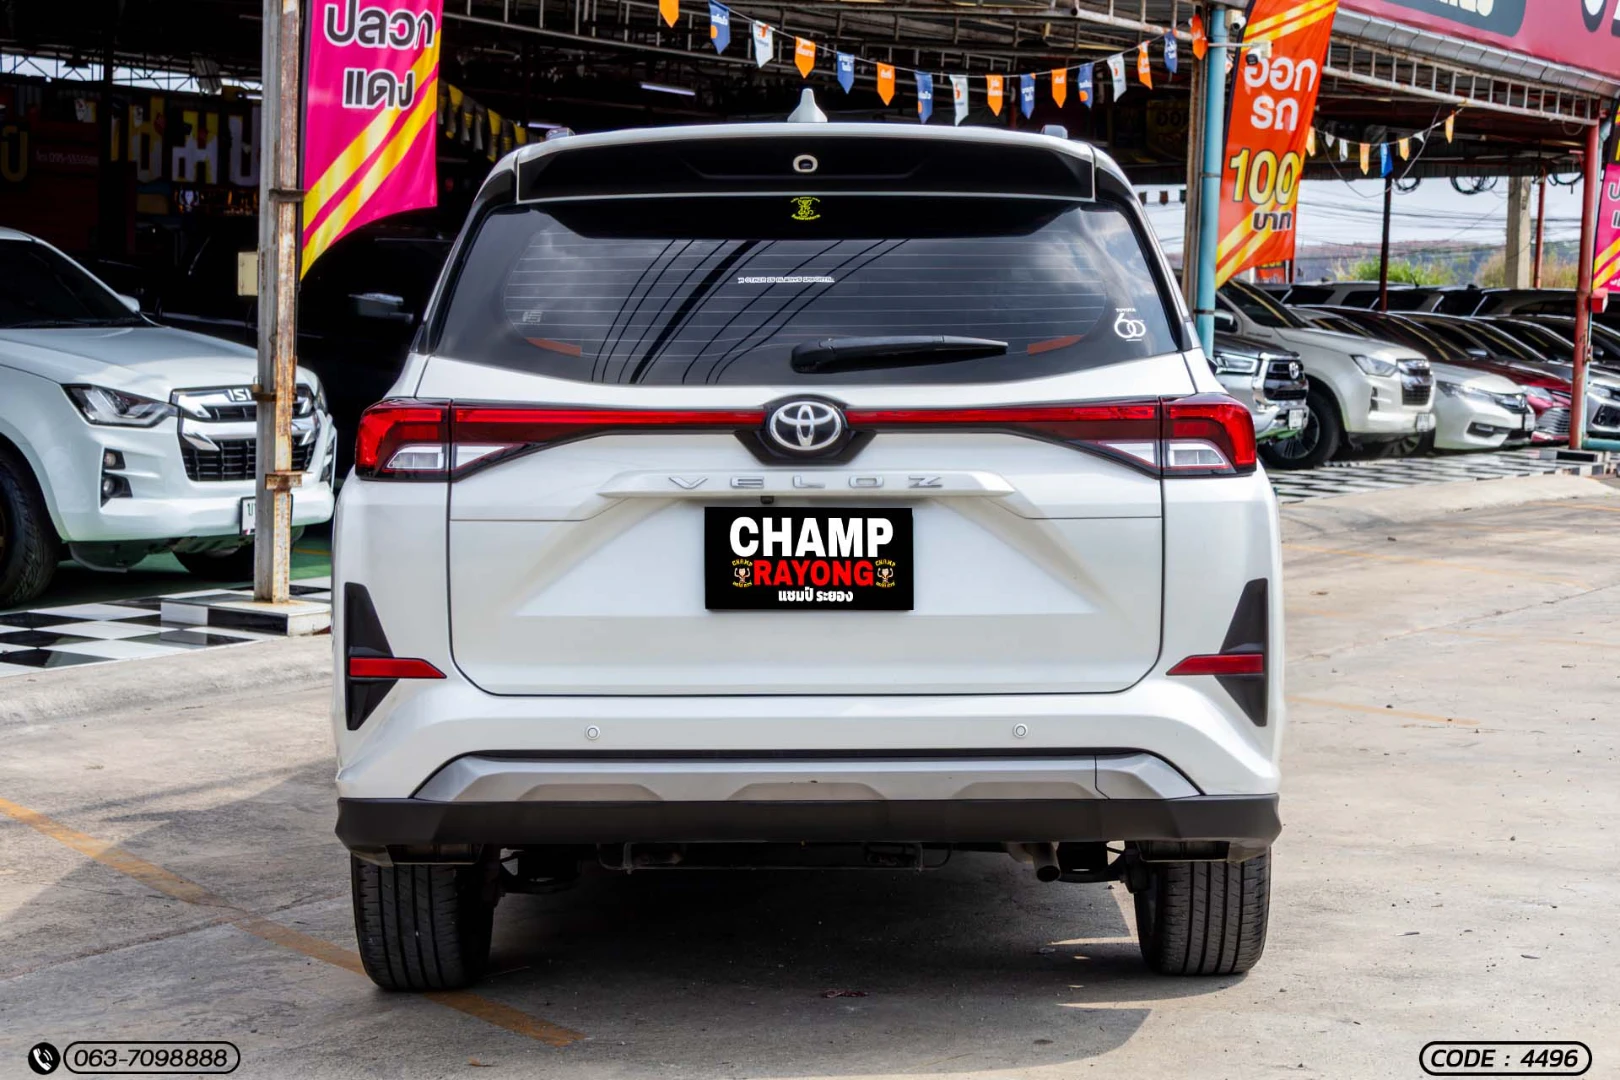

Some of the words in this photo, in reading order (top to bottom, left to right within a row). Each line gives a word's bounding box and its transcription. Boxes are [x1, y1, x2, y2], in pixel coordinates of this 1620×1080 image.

[323, 0, 436, 50] ปลวก
[342, 67, 416, 111] แดง
[1243, 55, 1318, 92] ออก
[1250, 95, 1299, 131] รถ
[1229, 147, 1301, 206] 100
[1251, 210, 1292, 232] บาท
[668, 476, 943, 489] VELOZ
[729, 516, 894, 557] CHAMP
[753, 559, 874, 586] RAYONG
[778, 586, 814, 602] แชมป์
[816, 590, 854, 602] ระยอง
